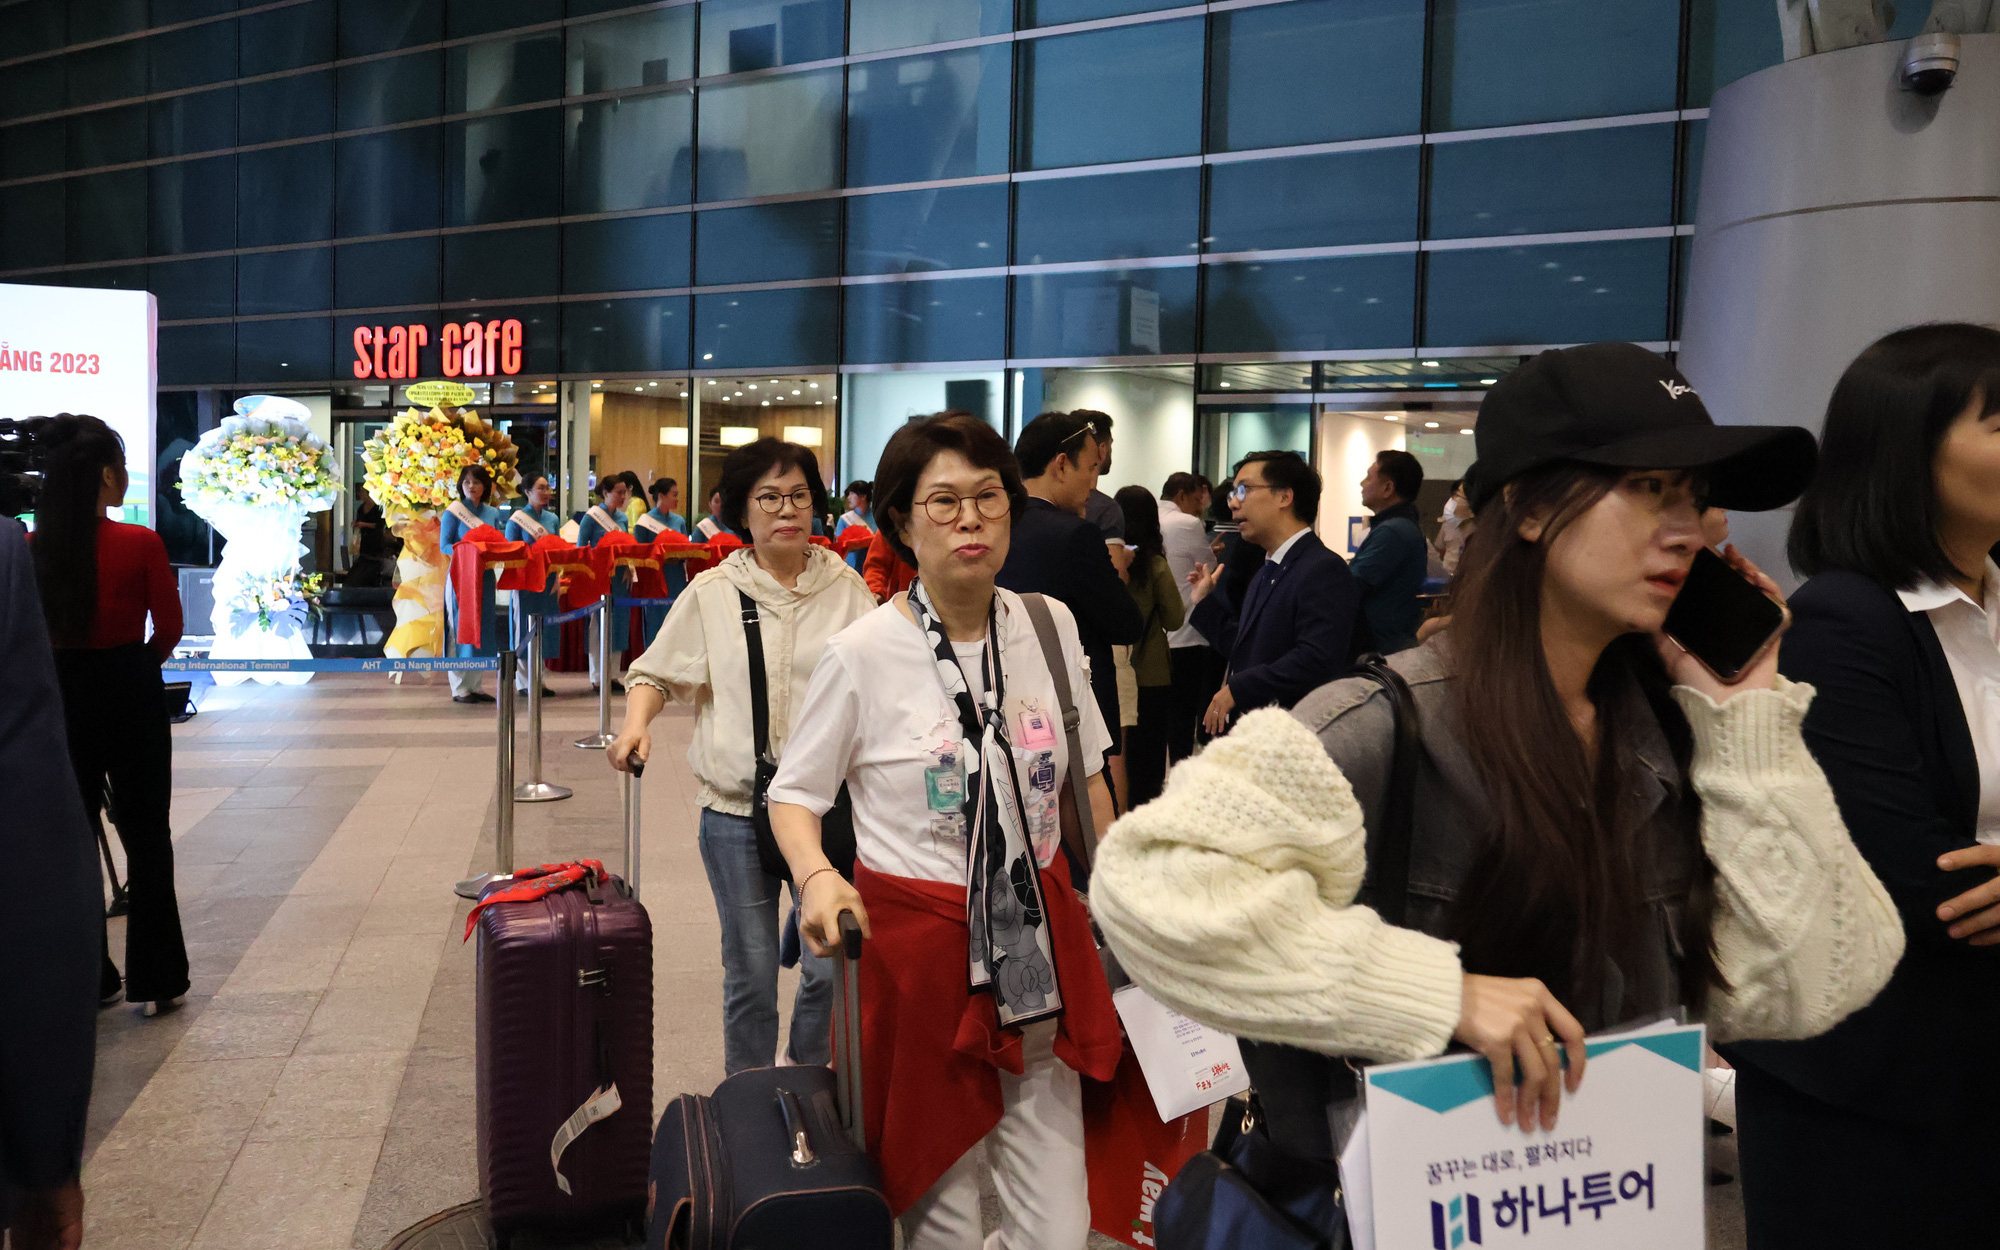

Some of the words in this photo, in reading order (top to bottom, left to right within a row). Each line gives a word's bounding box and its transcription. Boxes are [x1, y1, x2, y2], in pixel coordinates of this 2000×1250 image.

[50, 352, 100, 375] 2023
[188, 661, 248, 670] International
[250, 661, 290, 670] Terminal
[362, 661, 381, 670] AHT
[394, 661, 406, 670] Da
[408, 660, 431, 671] Nang
[433, 660, 488, 669] International
[1426, 1157, 1478, 1186] 꿈꾸는
[1525, 1135, 1593, 1167] 펼쳐지다
[1492, 1162, 1656, 1235] 하나투어
